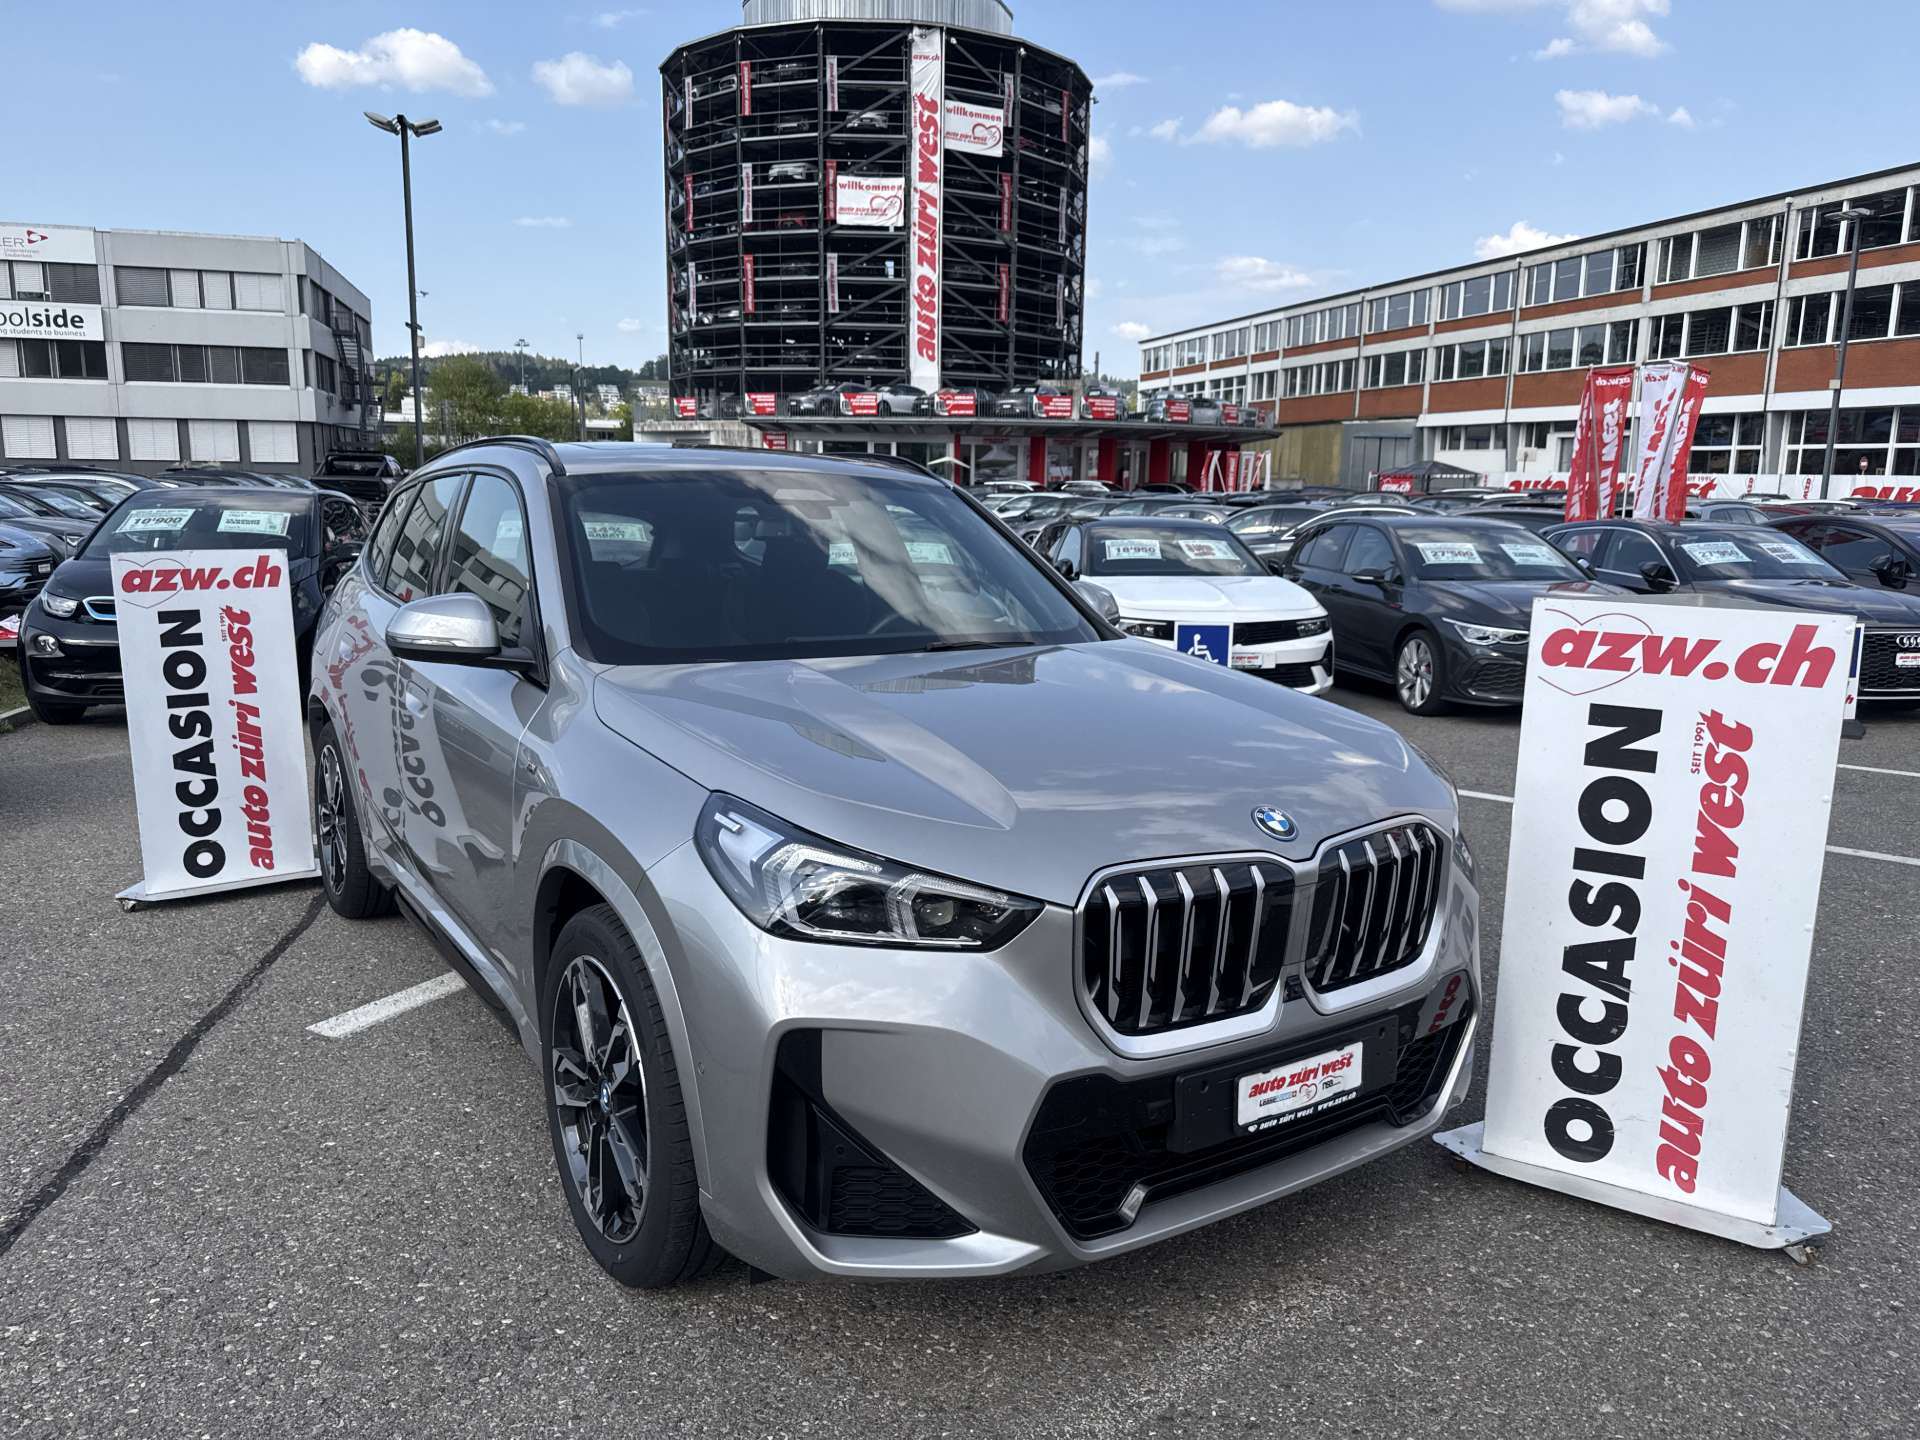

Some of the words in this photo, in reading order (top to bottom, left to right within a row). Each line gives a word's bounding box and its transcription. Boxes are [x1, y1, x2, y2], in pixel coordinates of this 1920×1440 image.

[914, 91, 939, 184] west
[945, 105, 1002, 122] willkommen
[838, 181, 903, 192] willkommen
[913, 186, 938, 273] züri
[9, 328, 43, 336] students
[54, 329, 87, 337] business
[913, 274, 938, 363] auto
[121, 555, 282, 593] azw.ch
[219, 604, 258, 695] west
[1540, 624, 1836, 689] azw.ch
[157, 608, 226, 879] OCCASION
[228, 699, 267, 783] züri
[1690, 752, 1703, 775] SEIT
[1694, 721, 1706, 748] 1991
[240, 784, 274, 870] auto
[1692, 708, 1755, 880] west
[1544, 702, 1664, 1164] OCCASION
[1667, 877, 1734, 1042] züri
[1248, 1073, 1286, 1098] auto
[1286, 1062, 1321, 1088] züri
[1321, 1052, 1354, 1077] west
[1655, 1033, 1713, 1194] auto
[1259, 1118, 1277, 1130] auto
[1297, 1106, 1314, 1119] west
